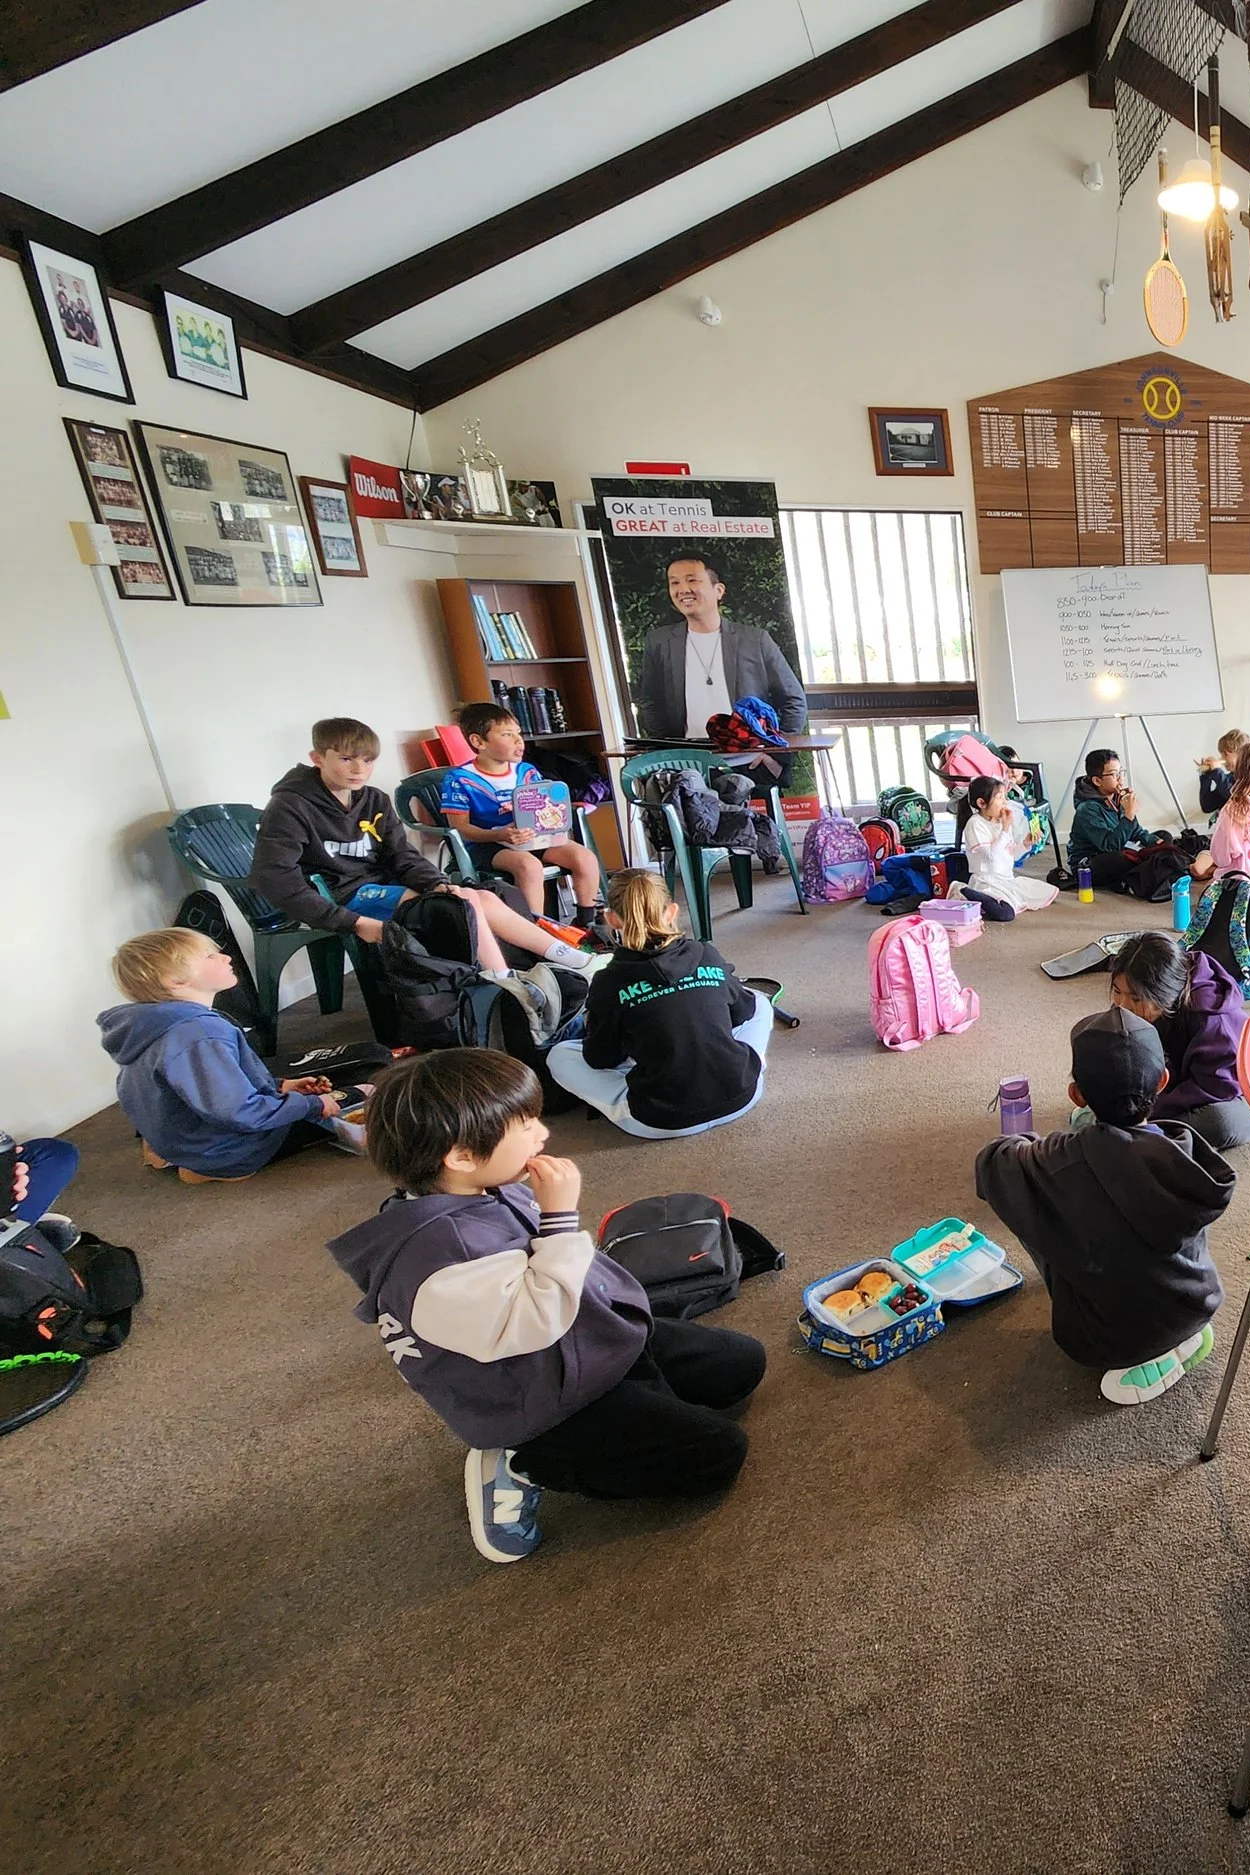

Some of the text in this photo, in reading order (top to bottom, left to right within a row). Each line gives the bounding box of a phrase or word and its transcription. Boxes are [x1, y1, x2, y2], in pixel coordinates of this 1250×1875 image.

[354, 472, 400, 503] Wilson
[611, 502, 707, 516] OK at Tennis
[616, 520, 769, 534] GREAT at Real Estate
[1112, 571, 1142, 588] Plan
[324, 832, 372, 858] PUMA
[618, 966, 725, 1004] AKE AKE
[637, 987, 675, 1004] FOREVER
[678, 980, 720, 991] LANGUAGE
